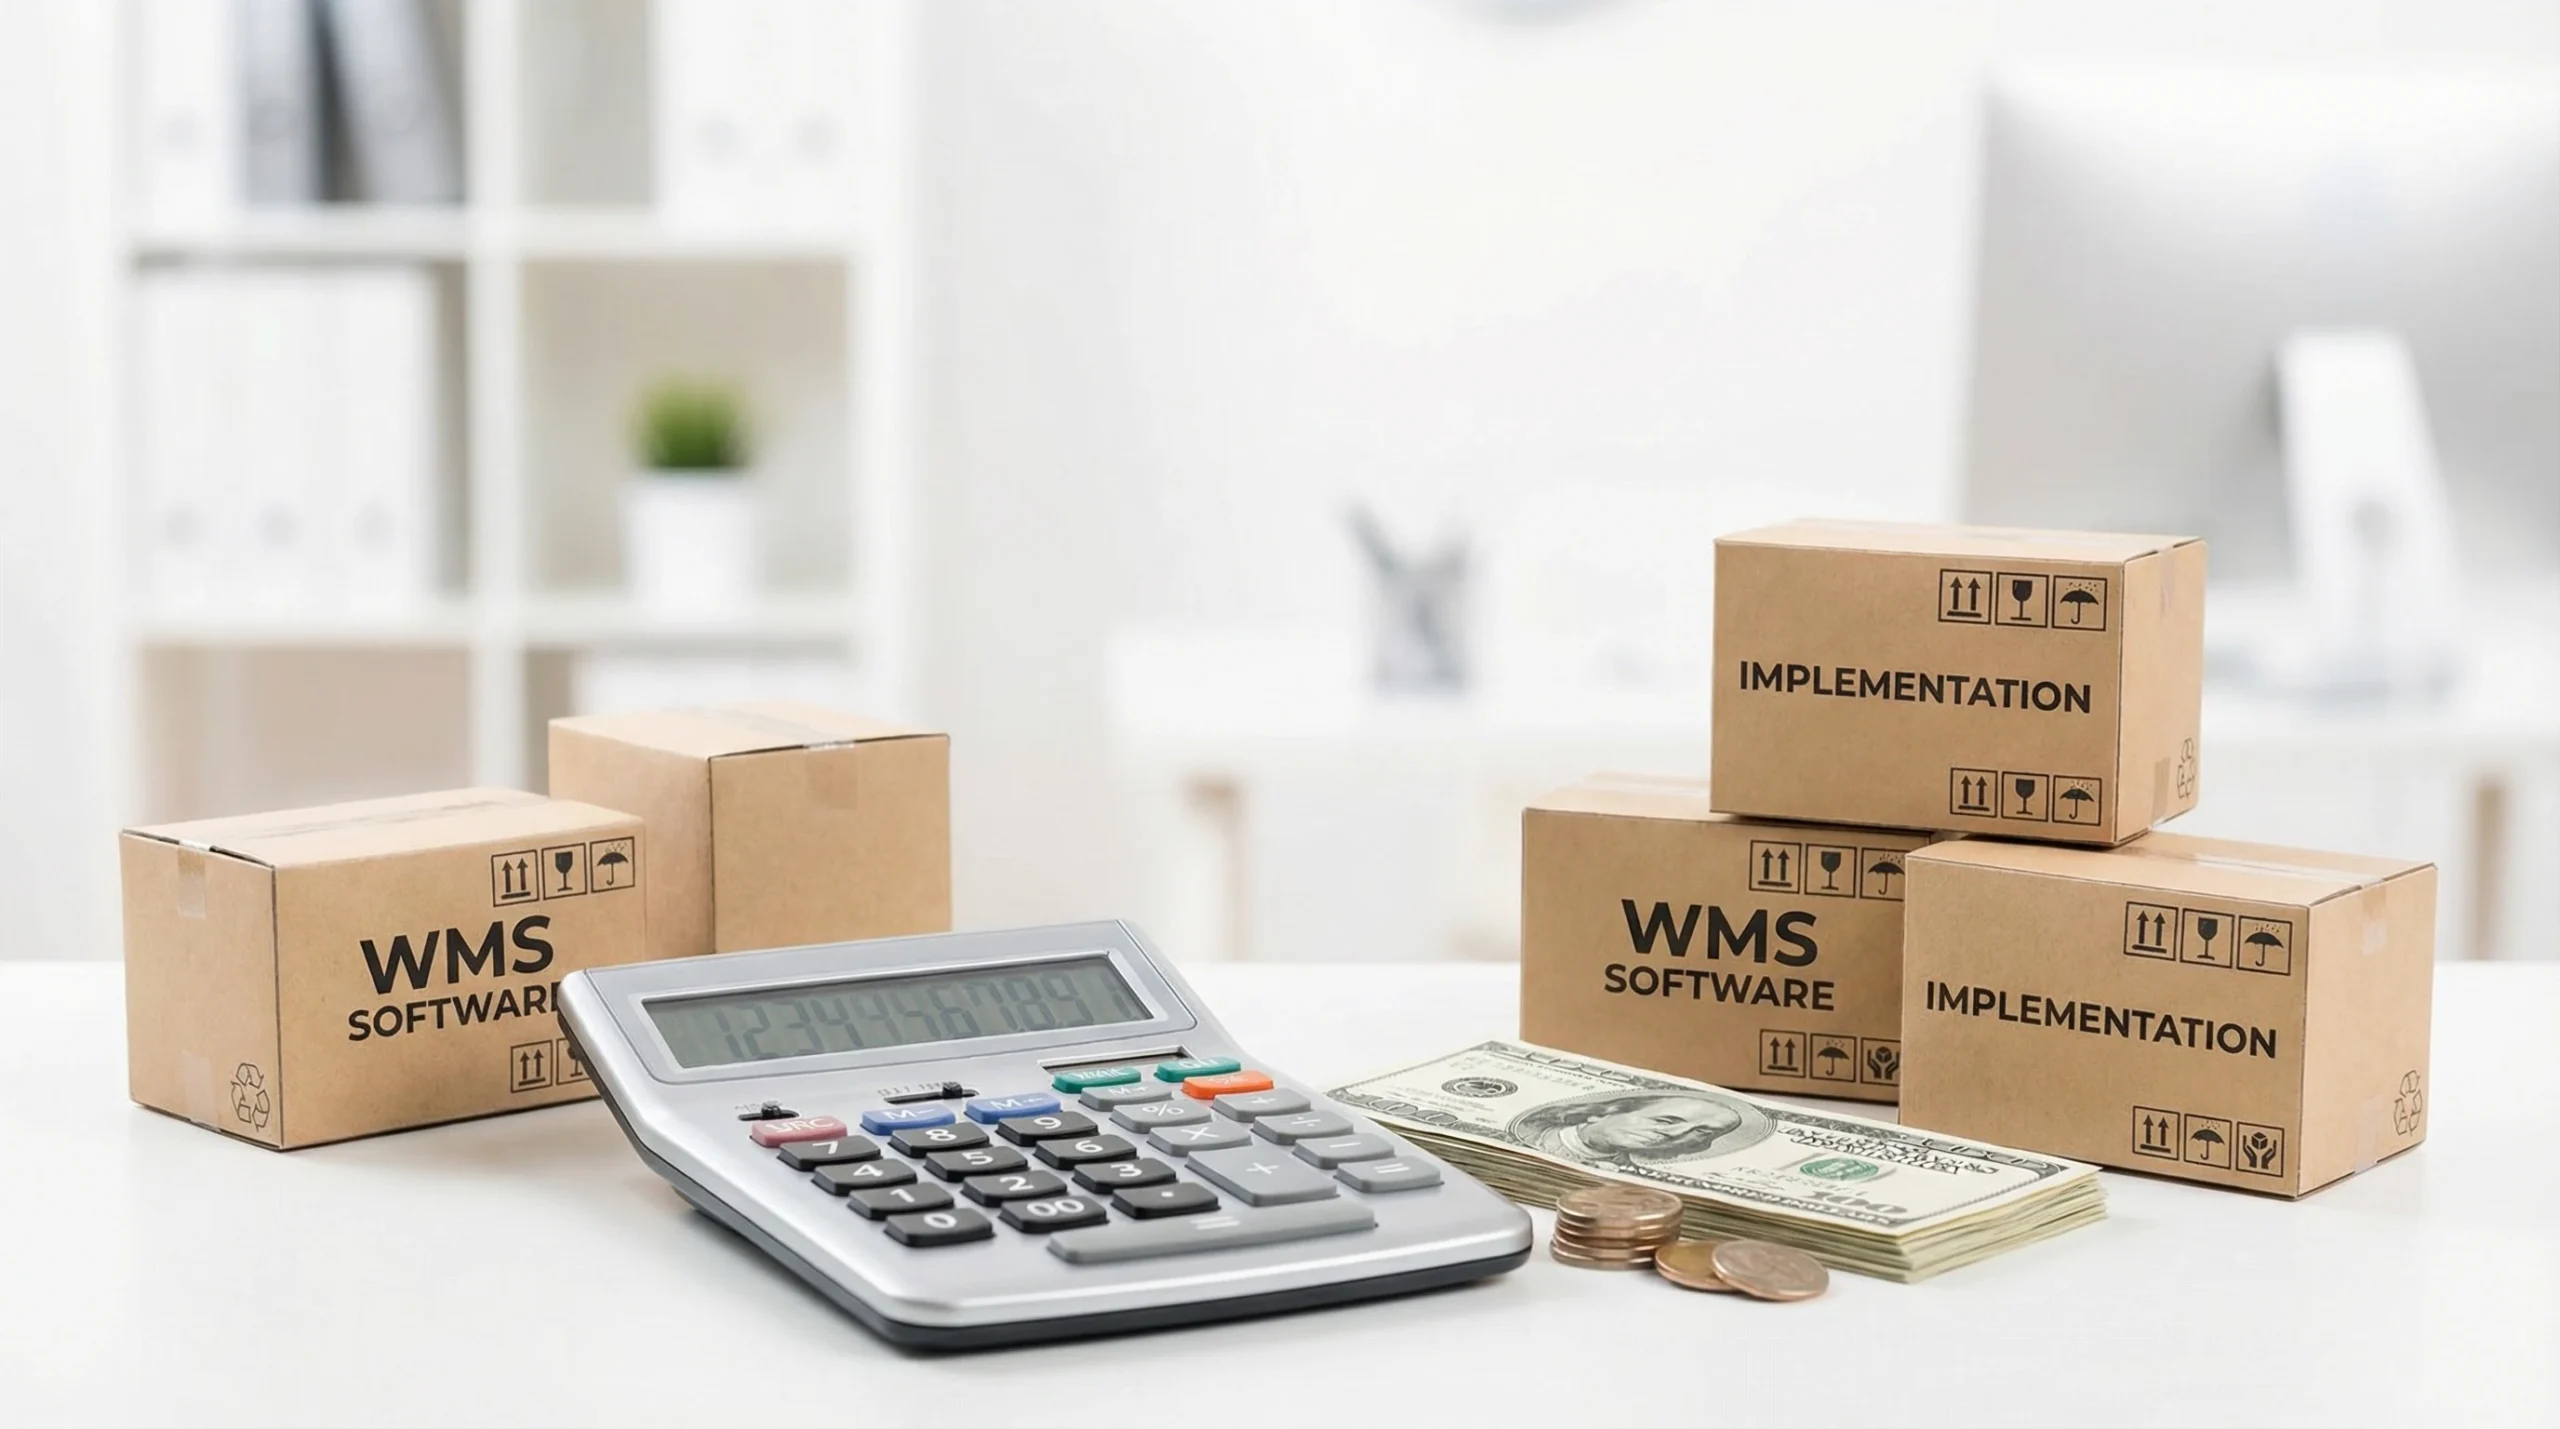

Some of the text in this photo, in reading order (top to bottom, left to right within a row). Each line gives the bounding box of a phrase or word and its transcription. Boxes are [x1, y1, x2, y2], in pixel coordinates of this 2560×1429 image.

[1740, 660, 2091, 714] IMPLEMENTATION
[1622, 898, 1818, 968] WMS
[360, 915, 554, 995] WMS
[1604, 963, 1835, 1012] SOFTWARE
[1926, 980, 2277, 1059] IMPLEMENTATION
[1033, 1116, 1062, 1129] 9
[925, 1128, 957, 1142] 8
[812, 1140, 839, 1154] 7
[1075, 1140, 1103, 1153] 6
[961, 1151, 994, 1165] 5
[853, 1163, 884, 1177] 4
[1110, 1163, 1143, 1177] 3
[999, 1176, 1034, 1191] 2
[889, 1188, 916, 1203] 1
[1026, 1199, 1085, 1217] 00
[924, 1212, 957, 1228] 0
